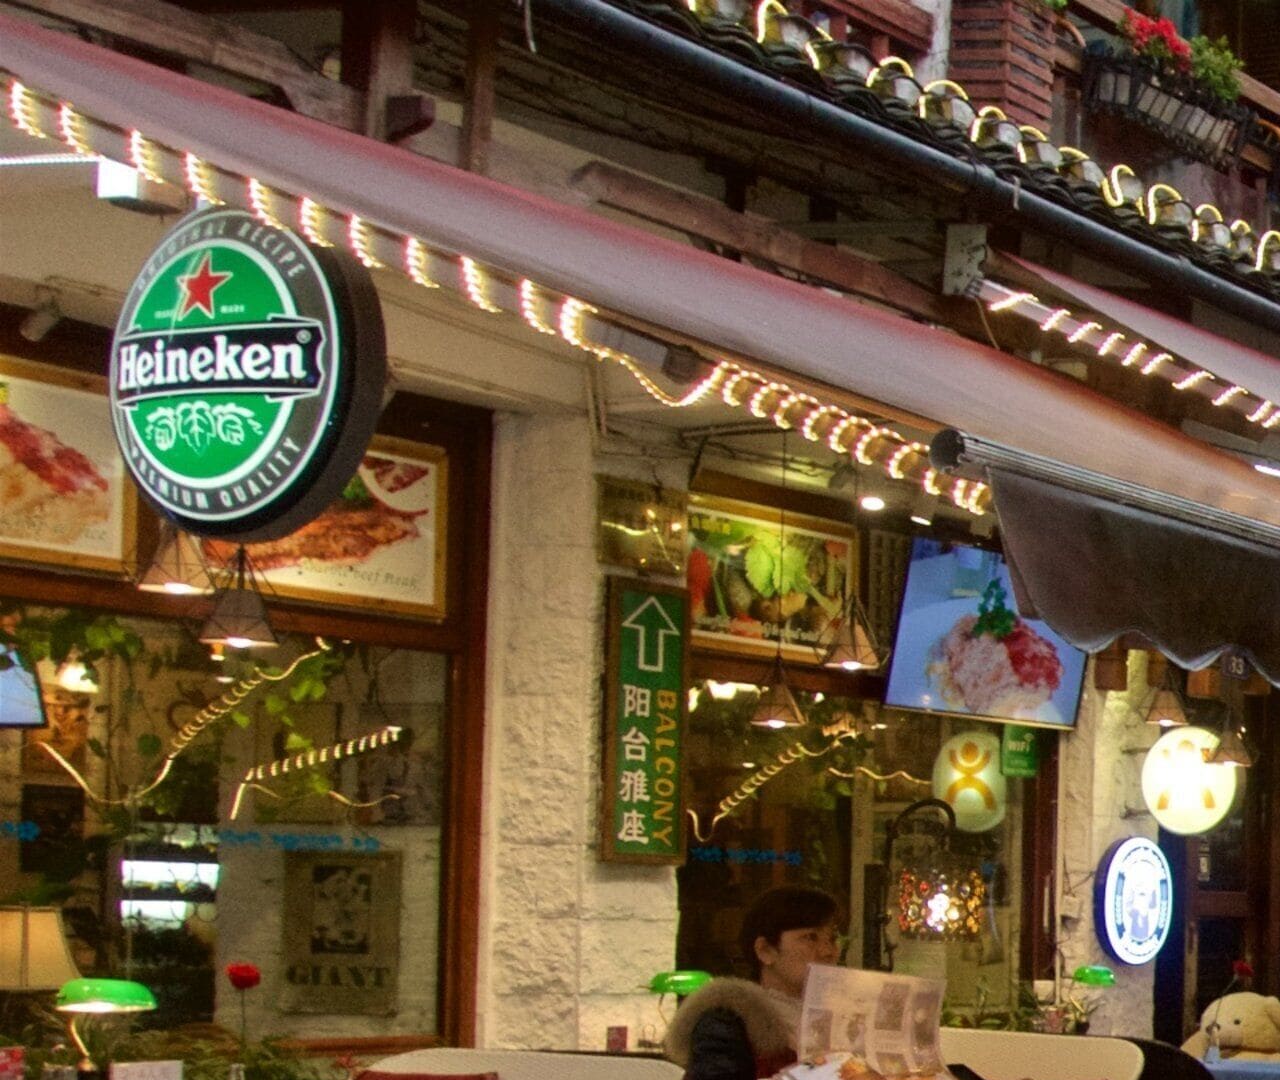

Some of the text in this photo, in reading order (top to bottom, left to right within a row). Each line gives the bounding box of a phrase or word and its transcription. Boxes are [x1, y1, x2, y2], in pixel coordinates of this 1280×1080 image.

[238, 221, 307, 278] RECIPE
[118, 334, 308, 392] Heineken
[130, 436, 304, 509] PREMIUM QUALITY
[617, 683, 651, 844] 阳台雅座
[654, 688, 679, 848] BALCONY
